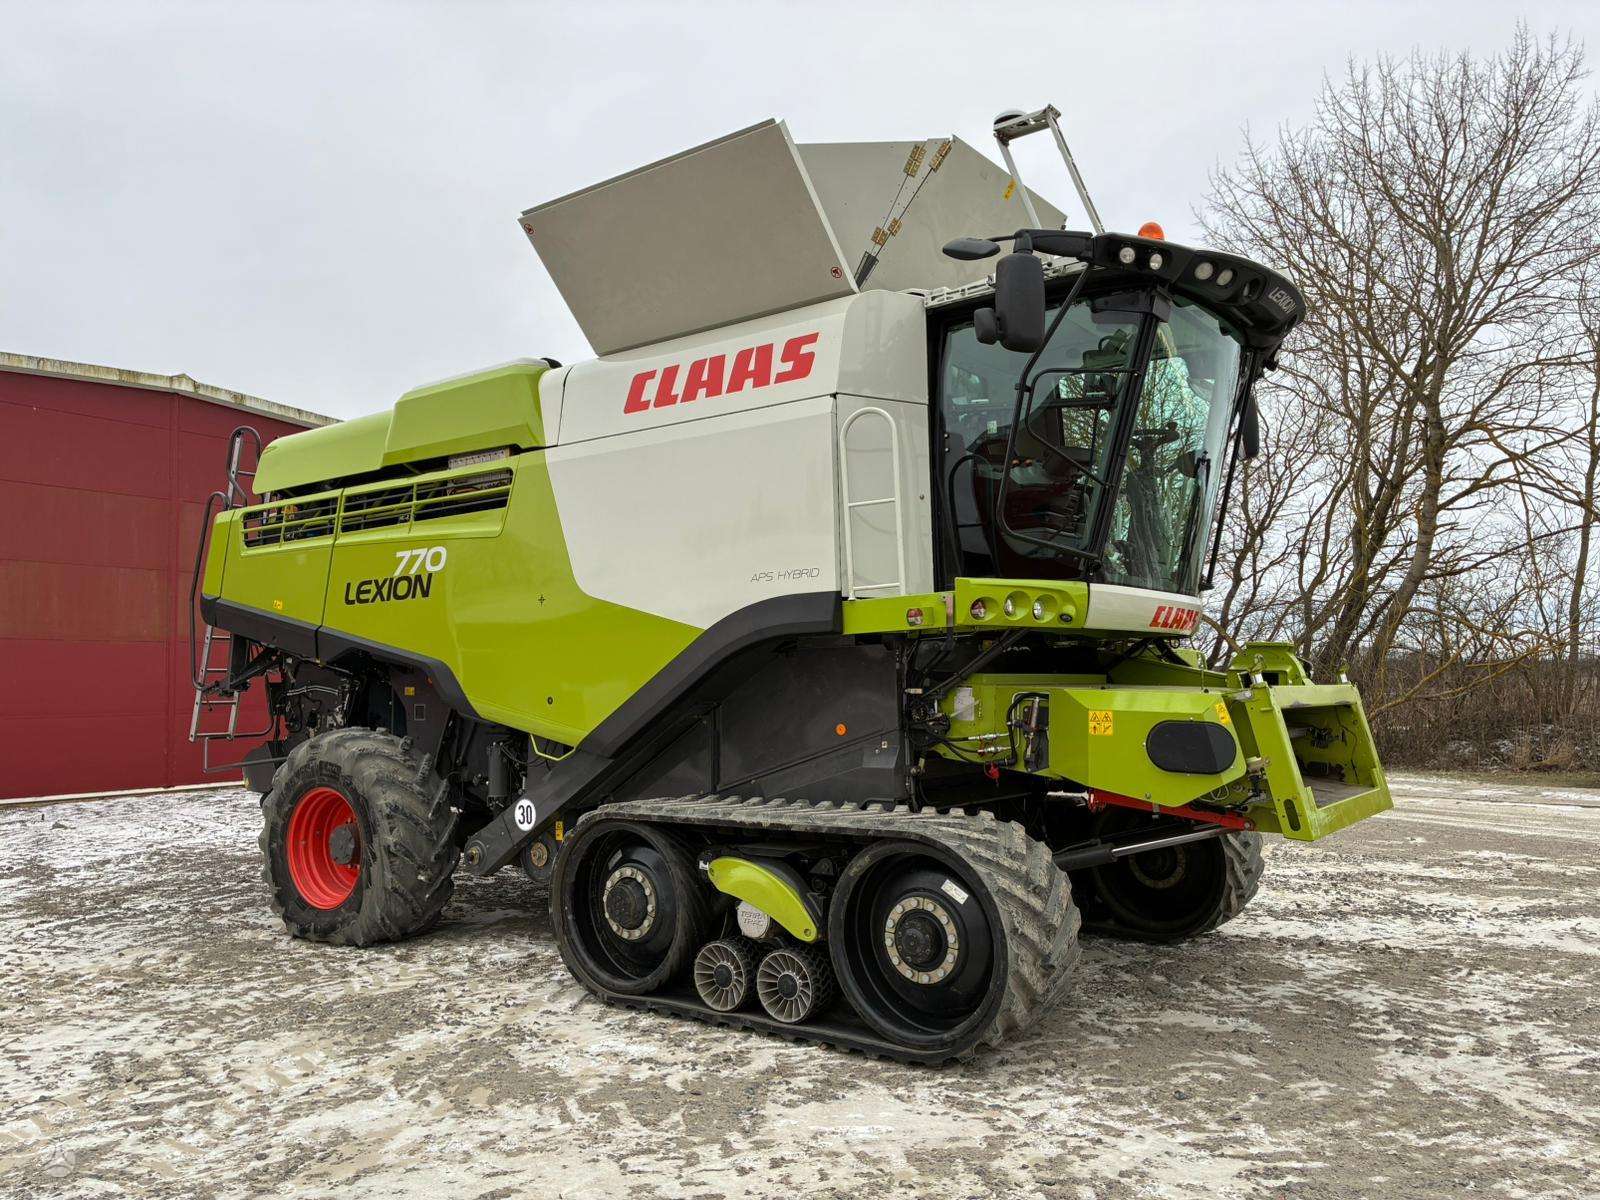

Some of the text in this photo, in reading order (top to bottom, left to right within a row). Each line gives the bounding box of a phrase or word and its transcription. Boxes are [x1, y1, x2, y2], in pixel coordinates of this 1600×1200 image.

[1268, 286, 1298, 316] LEXION
[623, 331, 820, 415] CLAAS
[393, 545, 448, 577] 770
[750, 567, 820, 583] APS HYBRID
[344, 572, 433, 606] LEXION
[518, 804, 533, 825] 30
